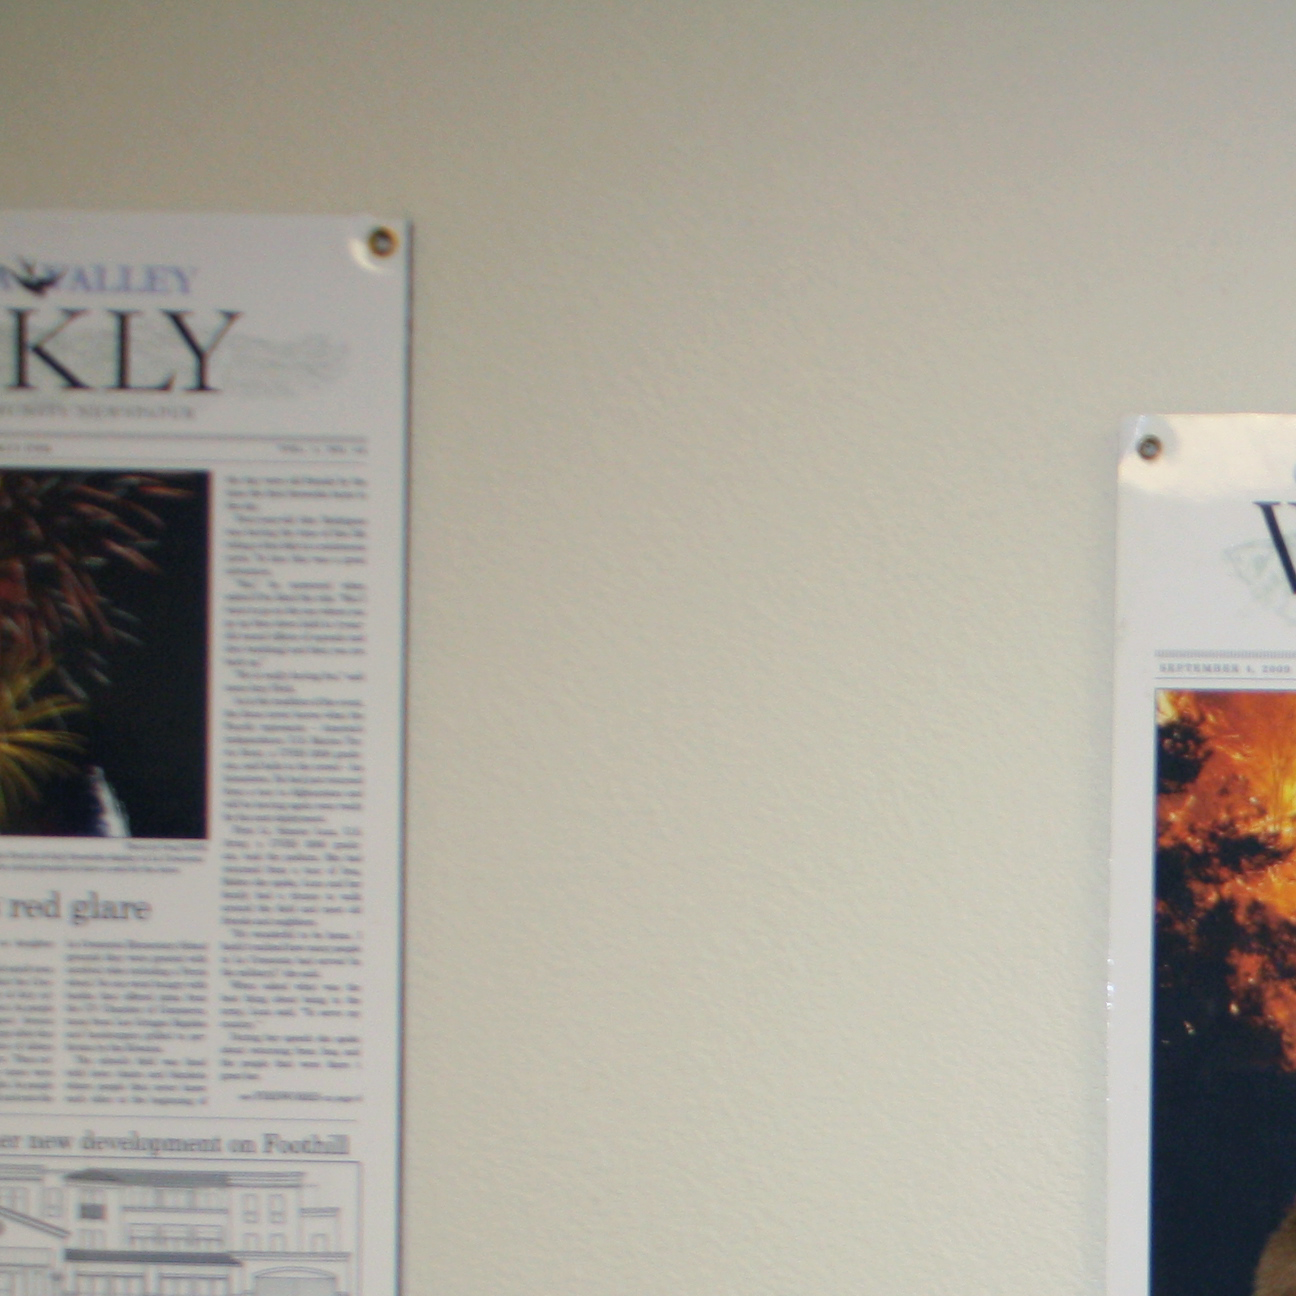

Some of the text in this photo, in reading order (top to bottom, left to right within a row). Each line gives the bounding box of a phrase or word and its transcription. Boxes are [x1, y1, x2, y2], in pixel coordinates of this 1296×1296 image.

[7, 309, 243, 392] KLY
[1159, 663, 1240, 674] SEPTEMBER
[7, 891, 153, 926] red glare
[78, 1132, 224, 1155] development
[228, 1138, 258, 1154] on
[261, 1133, 351, 1156] Foothill
